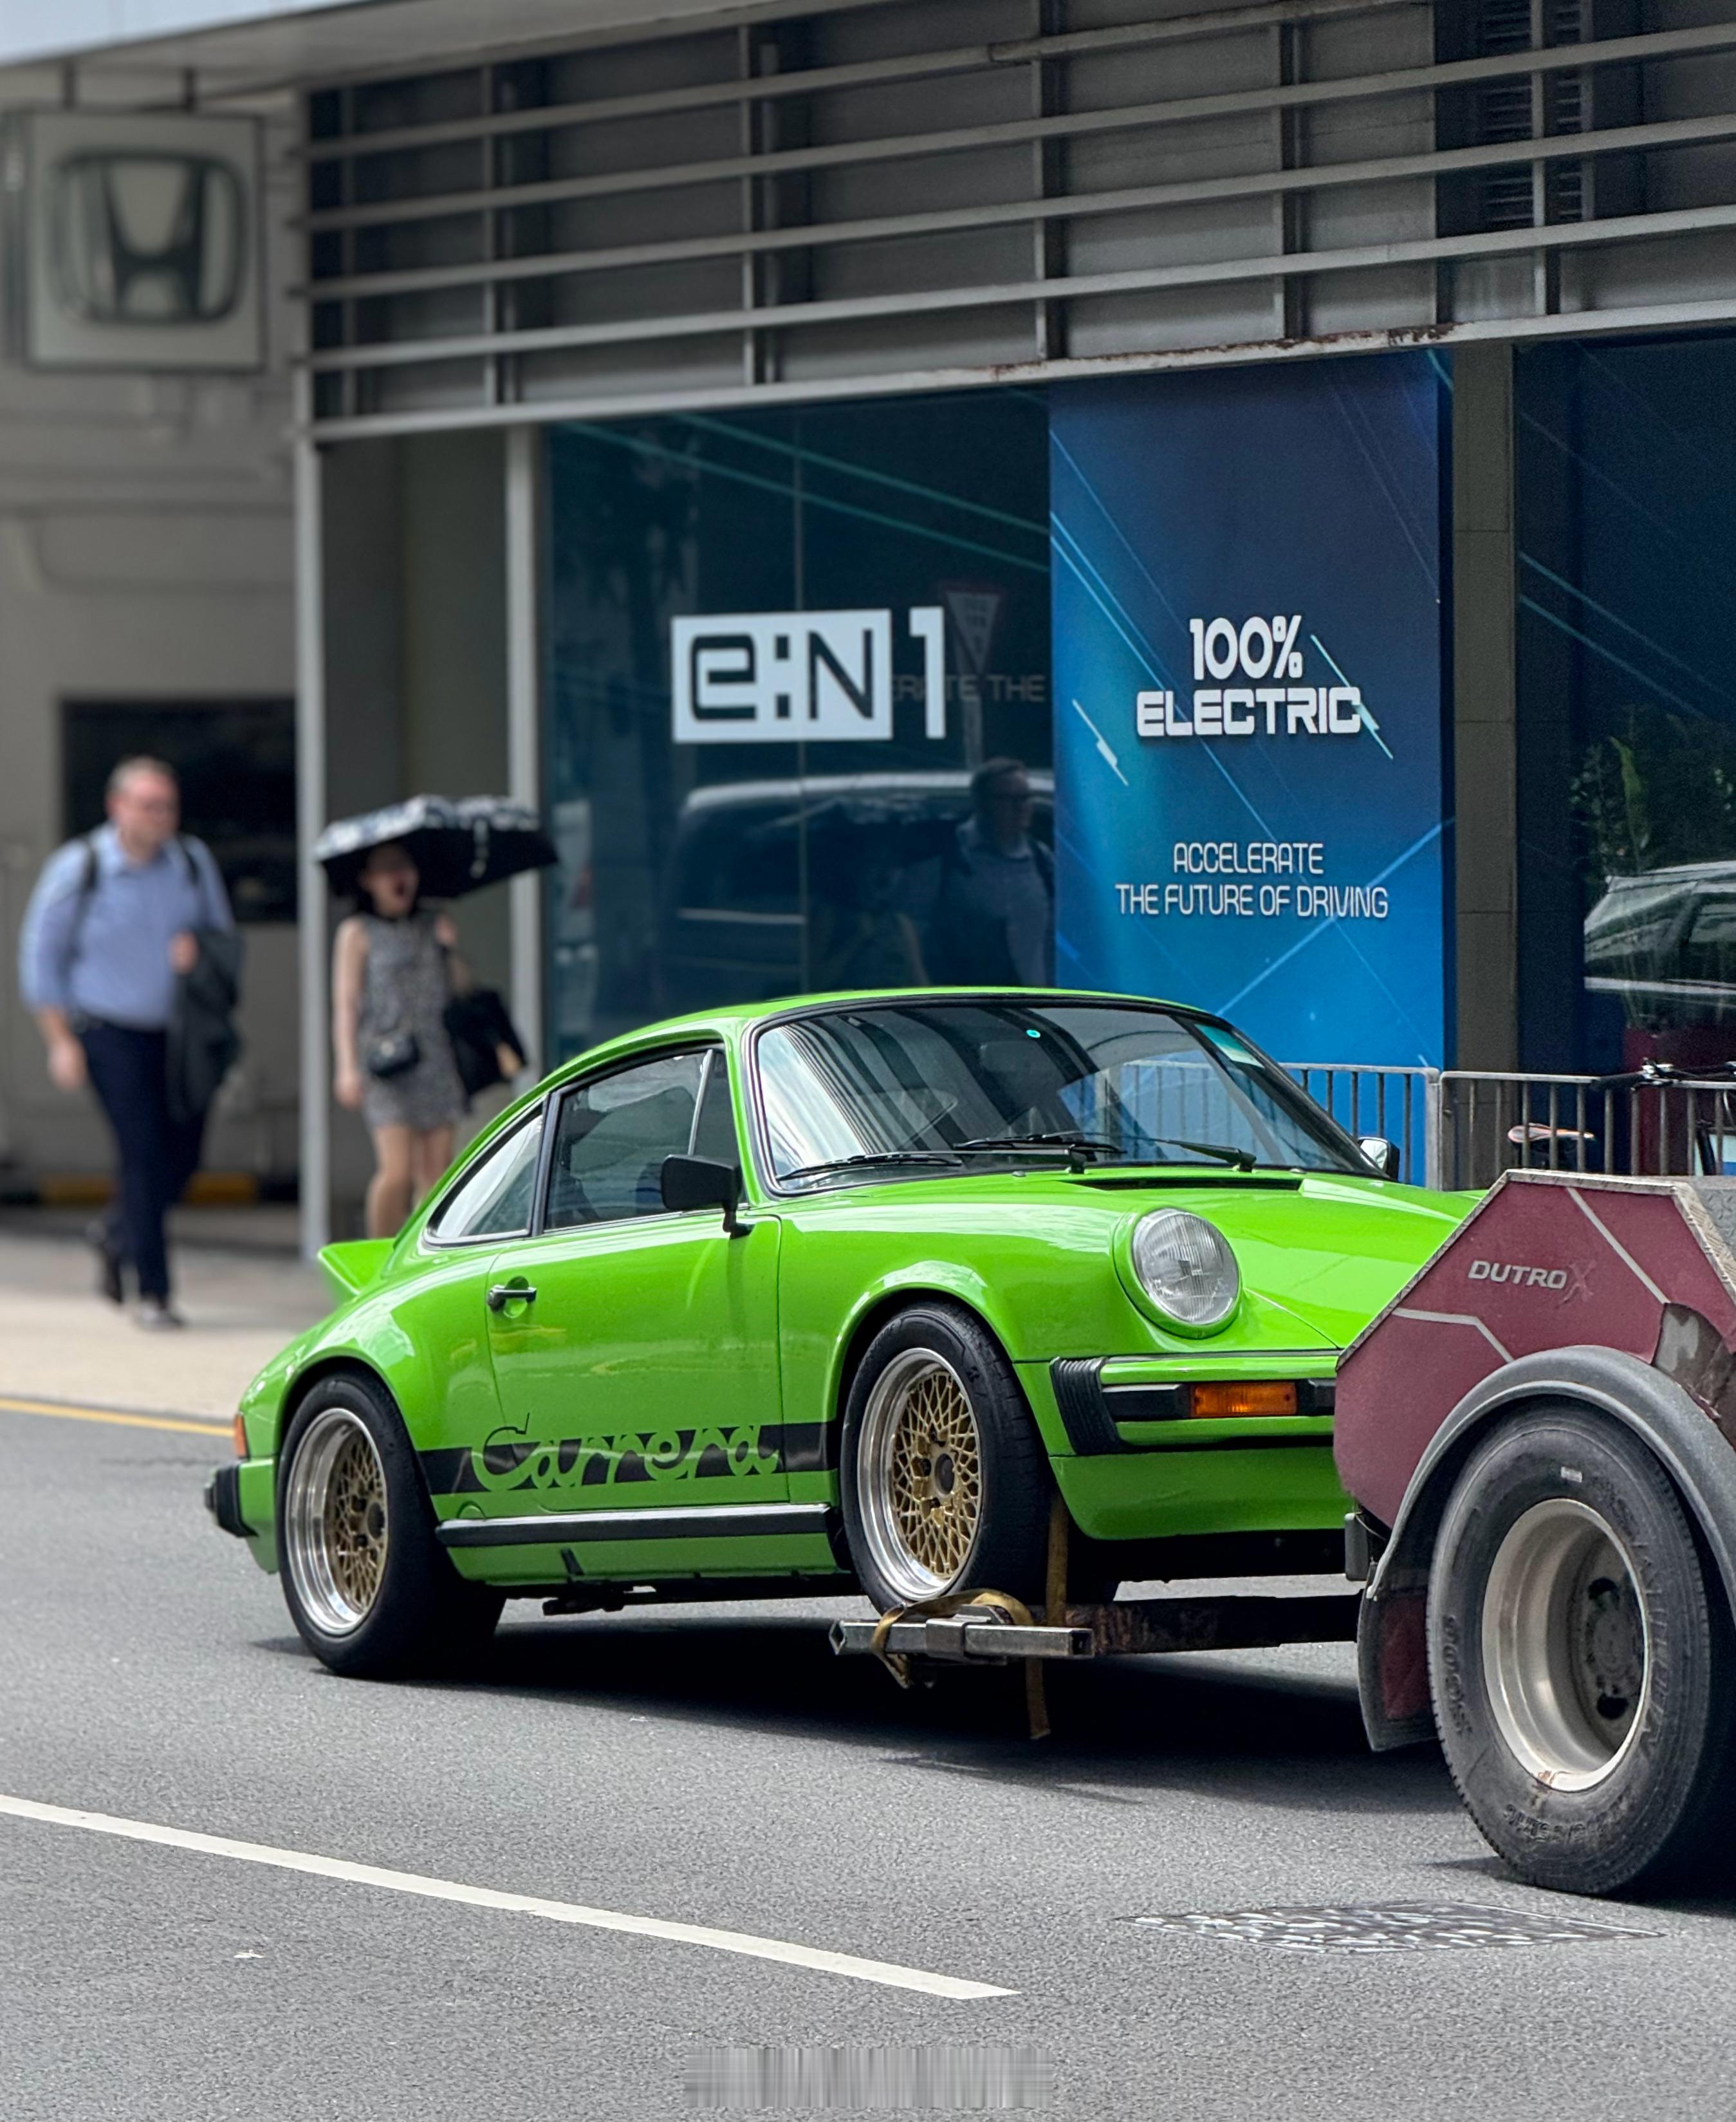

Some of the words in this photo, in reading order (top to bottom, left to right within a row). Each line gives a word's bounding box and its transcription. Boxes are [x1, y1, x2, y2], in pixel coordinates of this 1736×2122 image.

[1190, 615, 1303, 680] 100%
[986, 675, 1046, 703] THE
[1137, 687, 1361, 736] ELECTRIC
[1174, 842, 1324, 874] ACCELERATE
[1115, 884, 1159, 915] THE
[1165, 884, 1253, 915] FUTURE
[1260, 885, 1290, 915] OF
[1297, 886, 1389, 918] DRIVING
[1468, 1260, 1567, 1289] DUTRO
[472, 1413, 780, 1492] Carrera
